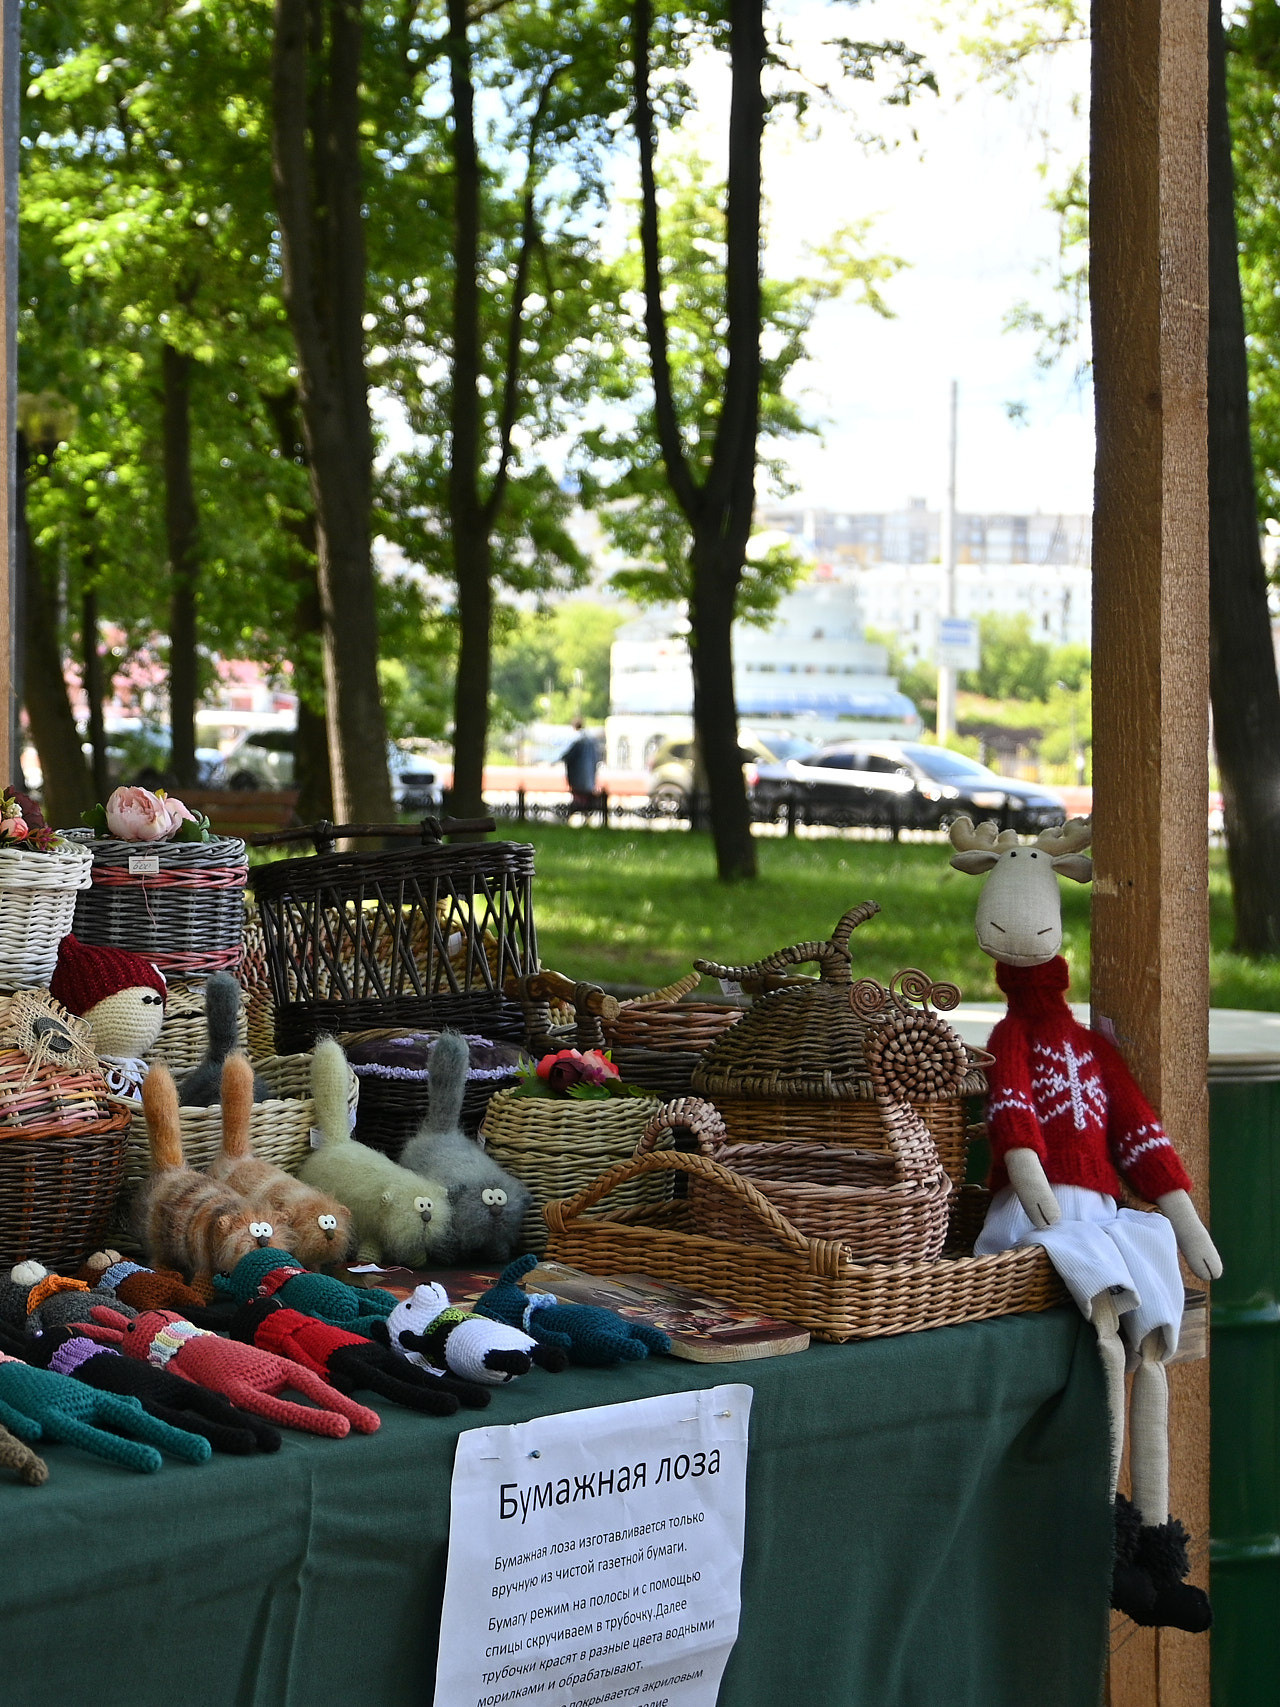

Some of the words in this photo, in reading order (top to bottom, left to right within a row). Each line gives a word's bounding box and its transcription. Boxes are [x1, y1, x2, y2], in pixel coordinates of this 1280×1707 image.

[500, 1462, 646, 1525] Бумажная
[655, 1449, 720, 1485] лоза
[492, 1576, 538, 1599] вручную
[541, 1572, 553, 1584] из
[556, 1559, 594, 1580] чистой
[598, 1547, 644, 1571] газетной
[647, 1542, 687, 1561] бумаги.
[494, 1546, 547, 1572] Бумажная
[550, 1540, 575, 1555] лоза
[579, 1520, 666, 1548] изготавливается
[668, 1512, 704, 1528] только
[488, 1612, 528, 1633] Бумагу
[530, 1602, 569, 1624] режим
[573, 1599, 586, 1611] на
[590, 1588, 630, 1607] полосы
[633, 1586, 639, 1597] и
[642, 1584, 647, 1594] с
[650, 1571, 701, 1592] помощью
[482, 1662, 536, 1685] трубочки
[539, 1653, 578, 1671] красят
[580, 1651, 586, 1660] в
[588, 1640, 630, 1661] разные
[632, 1632, 663, 1649] цвета
[665, 1619, 715, 1640] водными
[485, 1640, 522, 1658] спицы
[526, 1624, 593, 1649] скручиваем
[596, 1621, 602, 1632] в
[477, 1683, 545, 1707] морилками
[548, 1680, 556, 1690] и
[558, 1660, 643, 1688] обрабатывают.
[642, 1669, 703, 1692] акриловым
